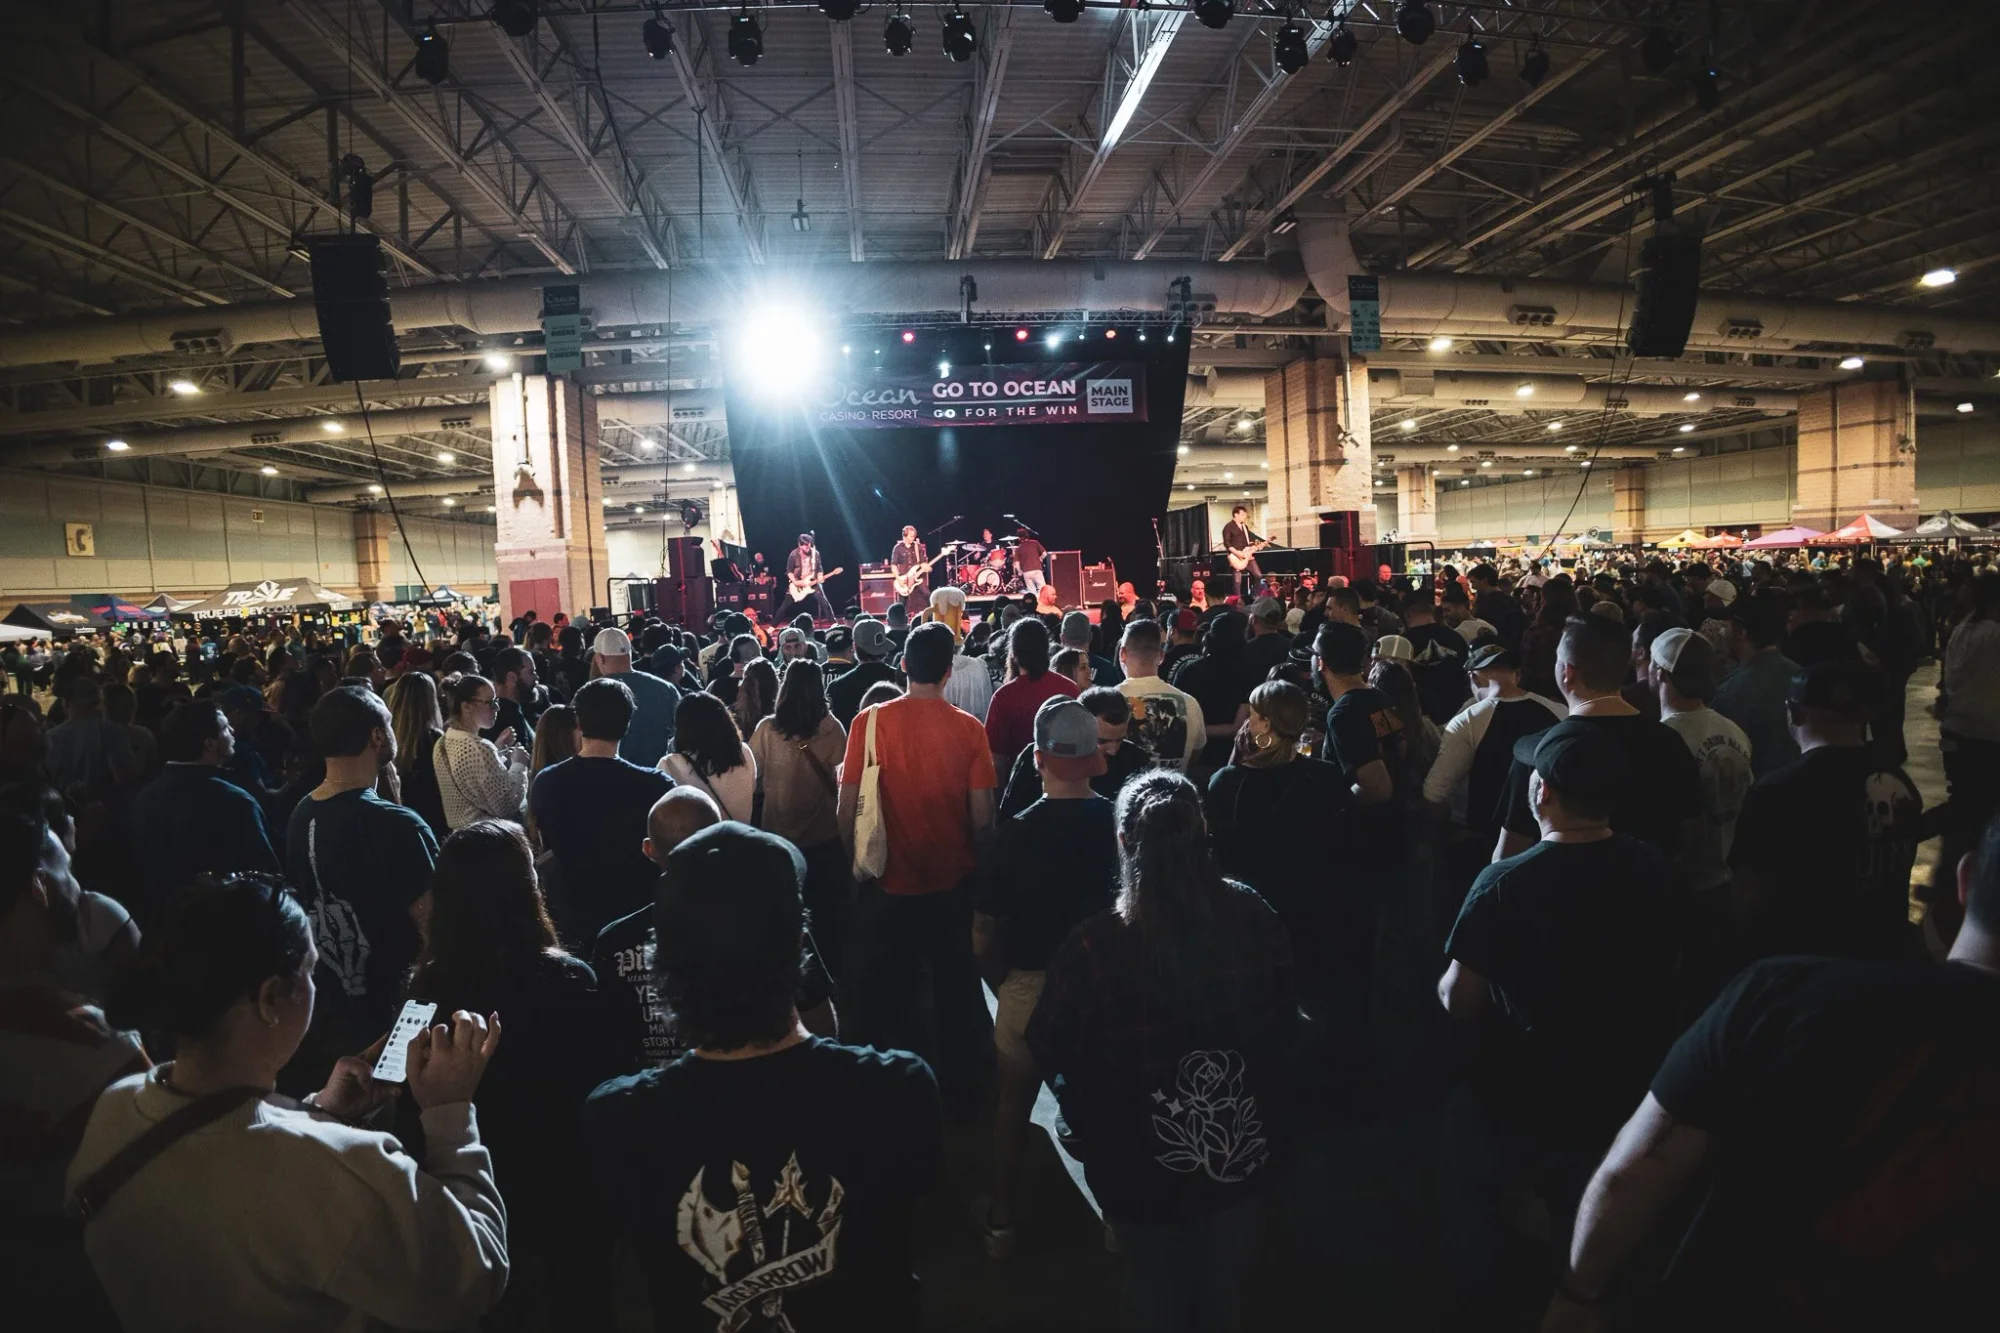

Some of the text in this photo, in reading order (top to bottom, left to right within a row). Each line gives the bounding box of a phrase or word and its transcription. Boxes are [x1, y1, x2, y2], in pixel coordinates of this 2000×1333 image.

[820, 379, 922, 408] Ocean
[932, 380, 1076, 398] GO TO OCEAN
[1091, 386, 1128, 397] MAIN
[1091, 397, 1129, 407] STAGE
[934, 405, 1077, 418] GO FOR THE WIN
[642, 1036, 676, 1048] STORY
